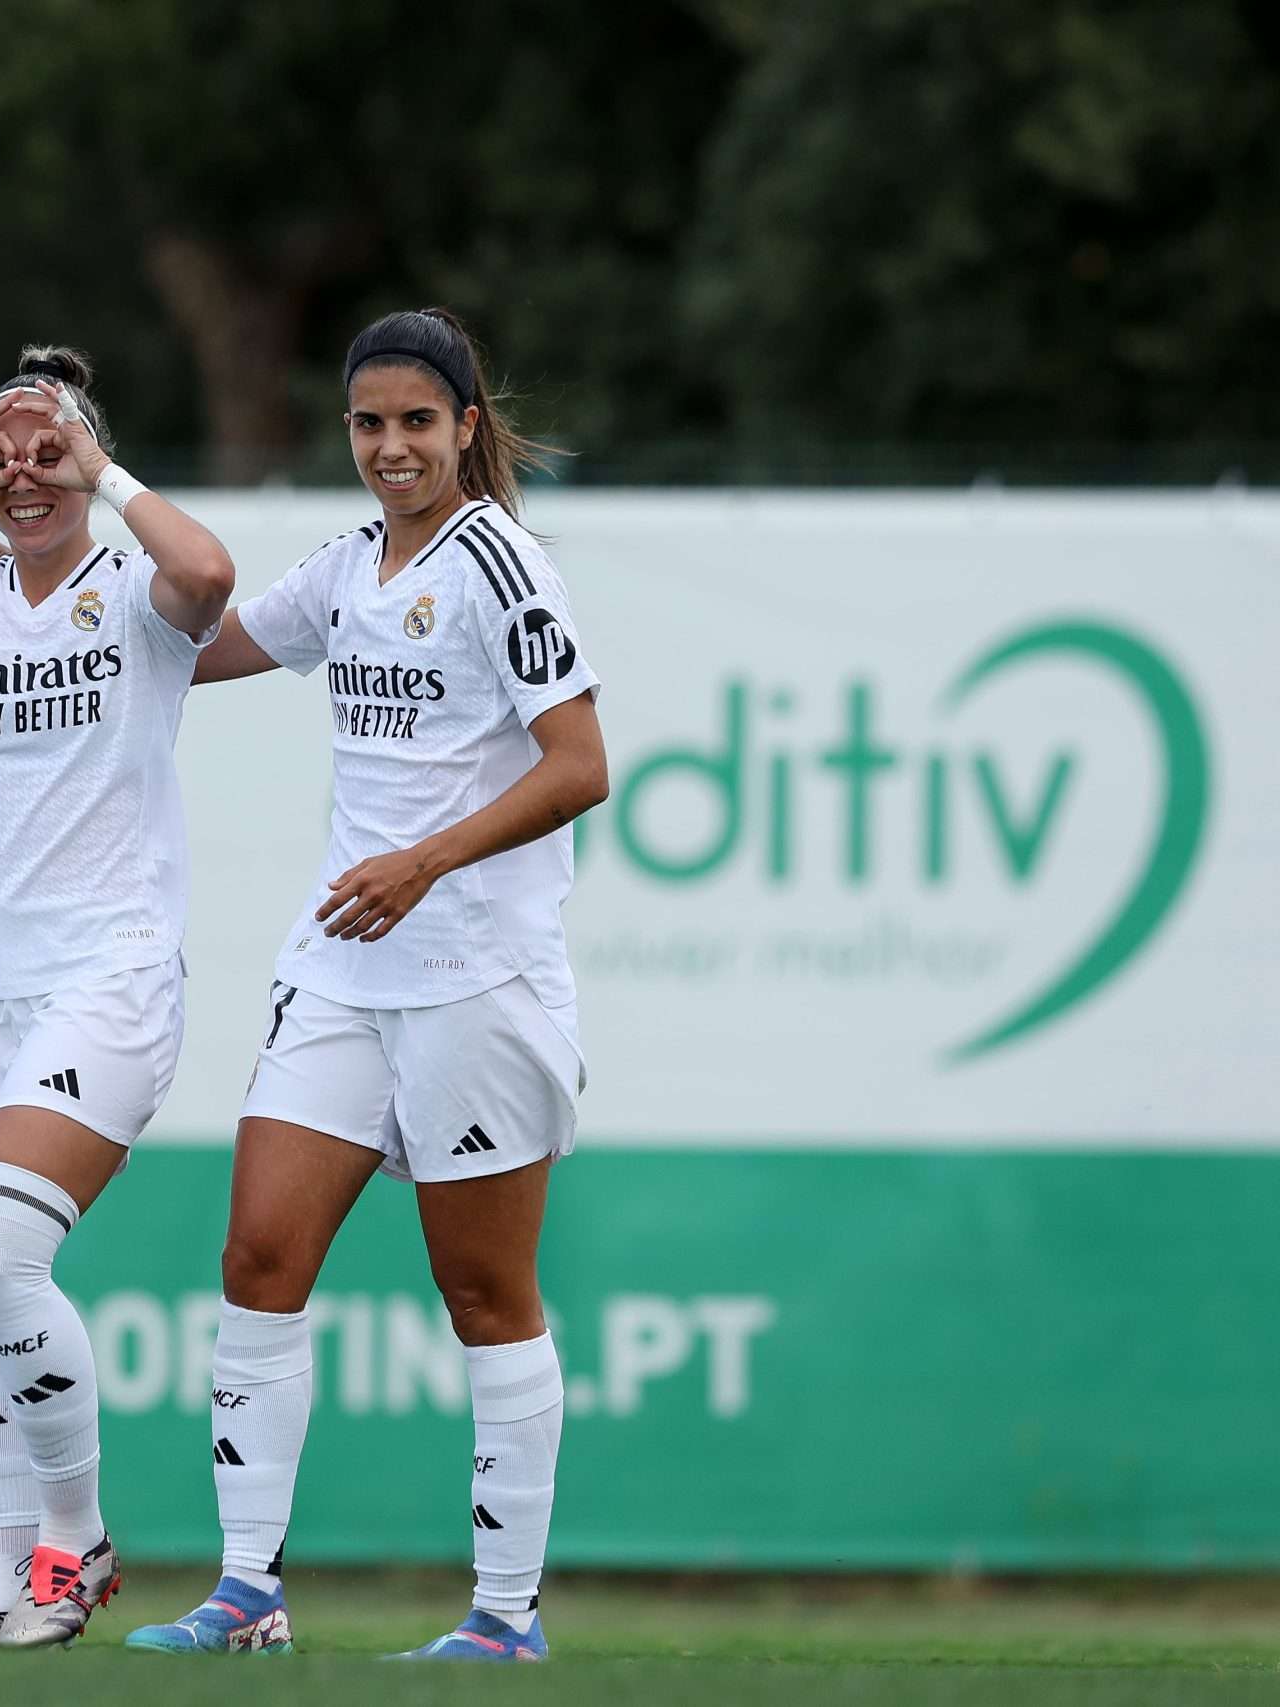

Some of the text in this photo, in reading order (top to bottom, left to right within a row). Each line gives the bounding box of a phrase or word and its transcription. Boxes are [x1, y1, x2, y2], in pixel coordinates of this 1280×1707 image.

[516, 609, 568, 685] hp
[328, 654, 445, 701] mirates
[15, 690, 101, 733] BETTER
[351, 703, 419, 738] BETTER
[575, 677, 1078, 884] ditiv
[212, 1387, 250, 1409] MCF
